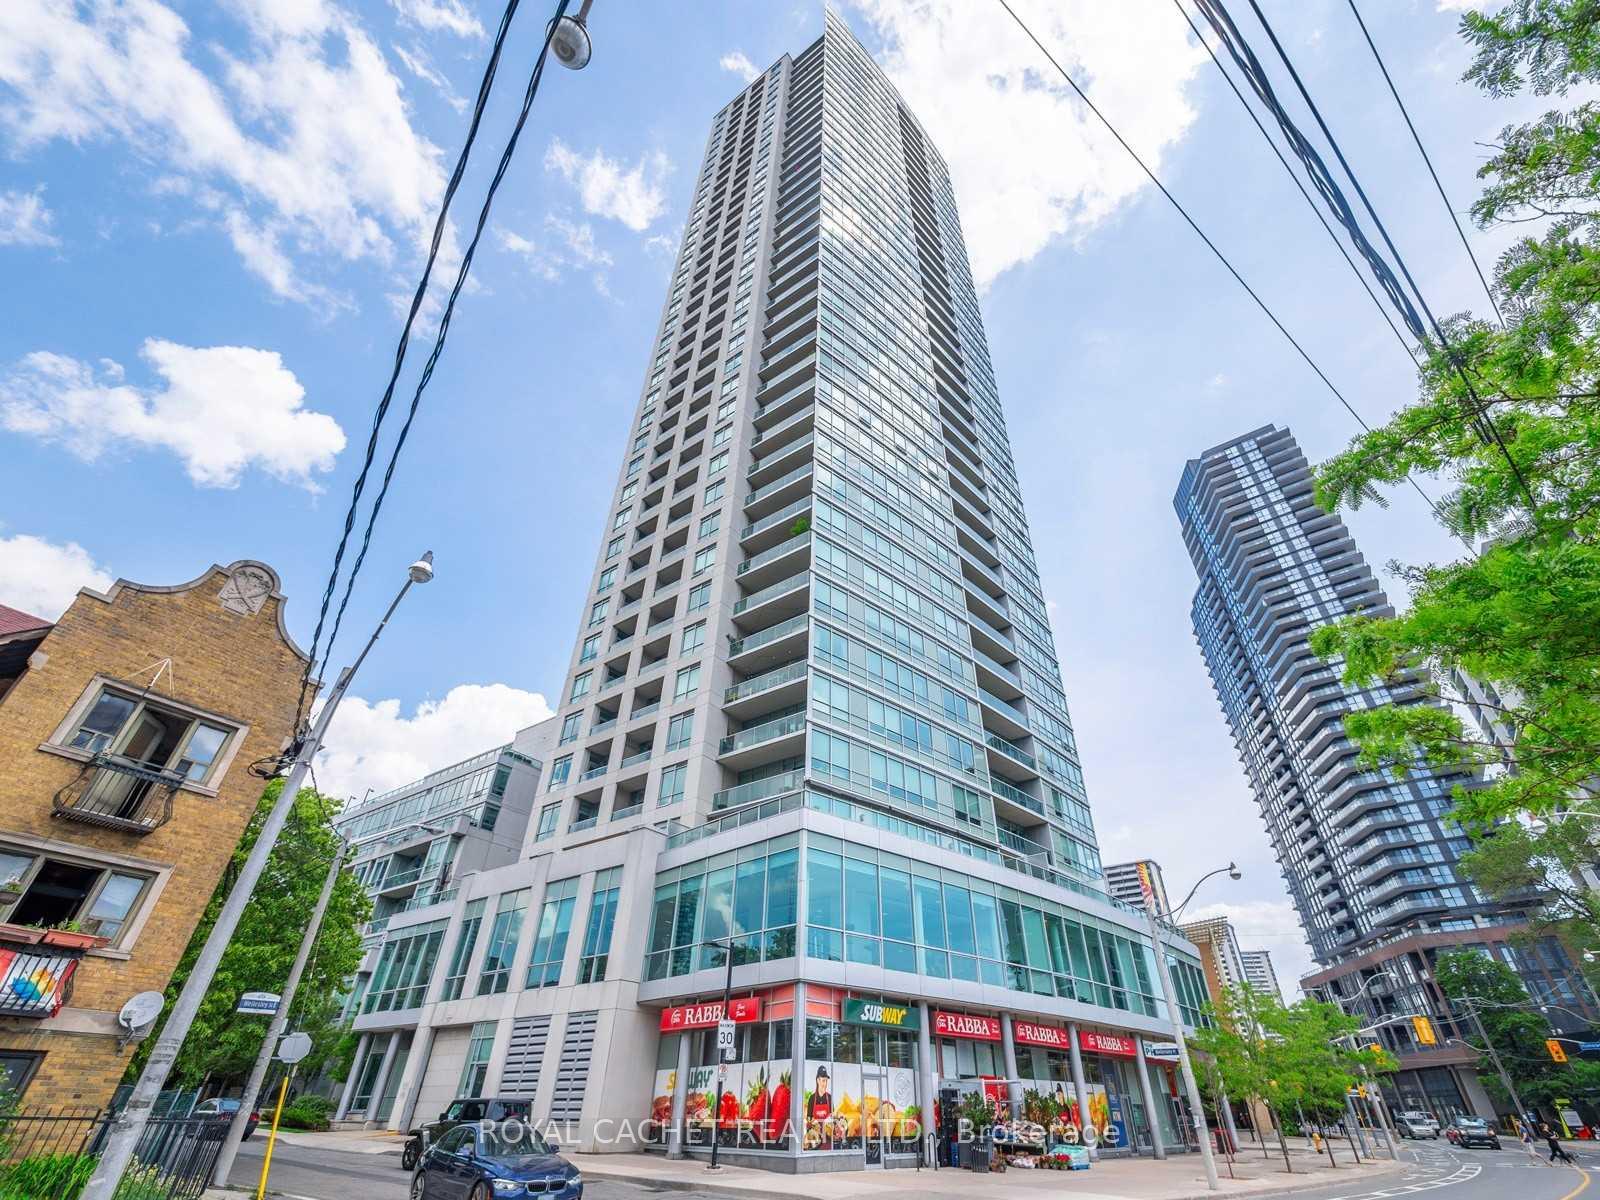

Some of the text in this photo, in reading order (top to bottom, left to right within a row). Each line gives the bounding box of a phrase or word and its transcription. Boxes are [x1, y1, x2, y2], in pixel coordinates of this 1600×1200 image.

[860, 1004, 907, 1024] SUBWAY
[946, 1015, 991, 1036] RABBA
[1024, 1025, 1061, 1044] RABBA
[719, 1031, 733, 1044] 30
[1095, 1035, 1124, 1052] RABBA
[667, 1069, 713, 1089] SWAY
